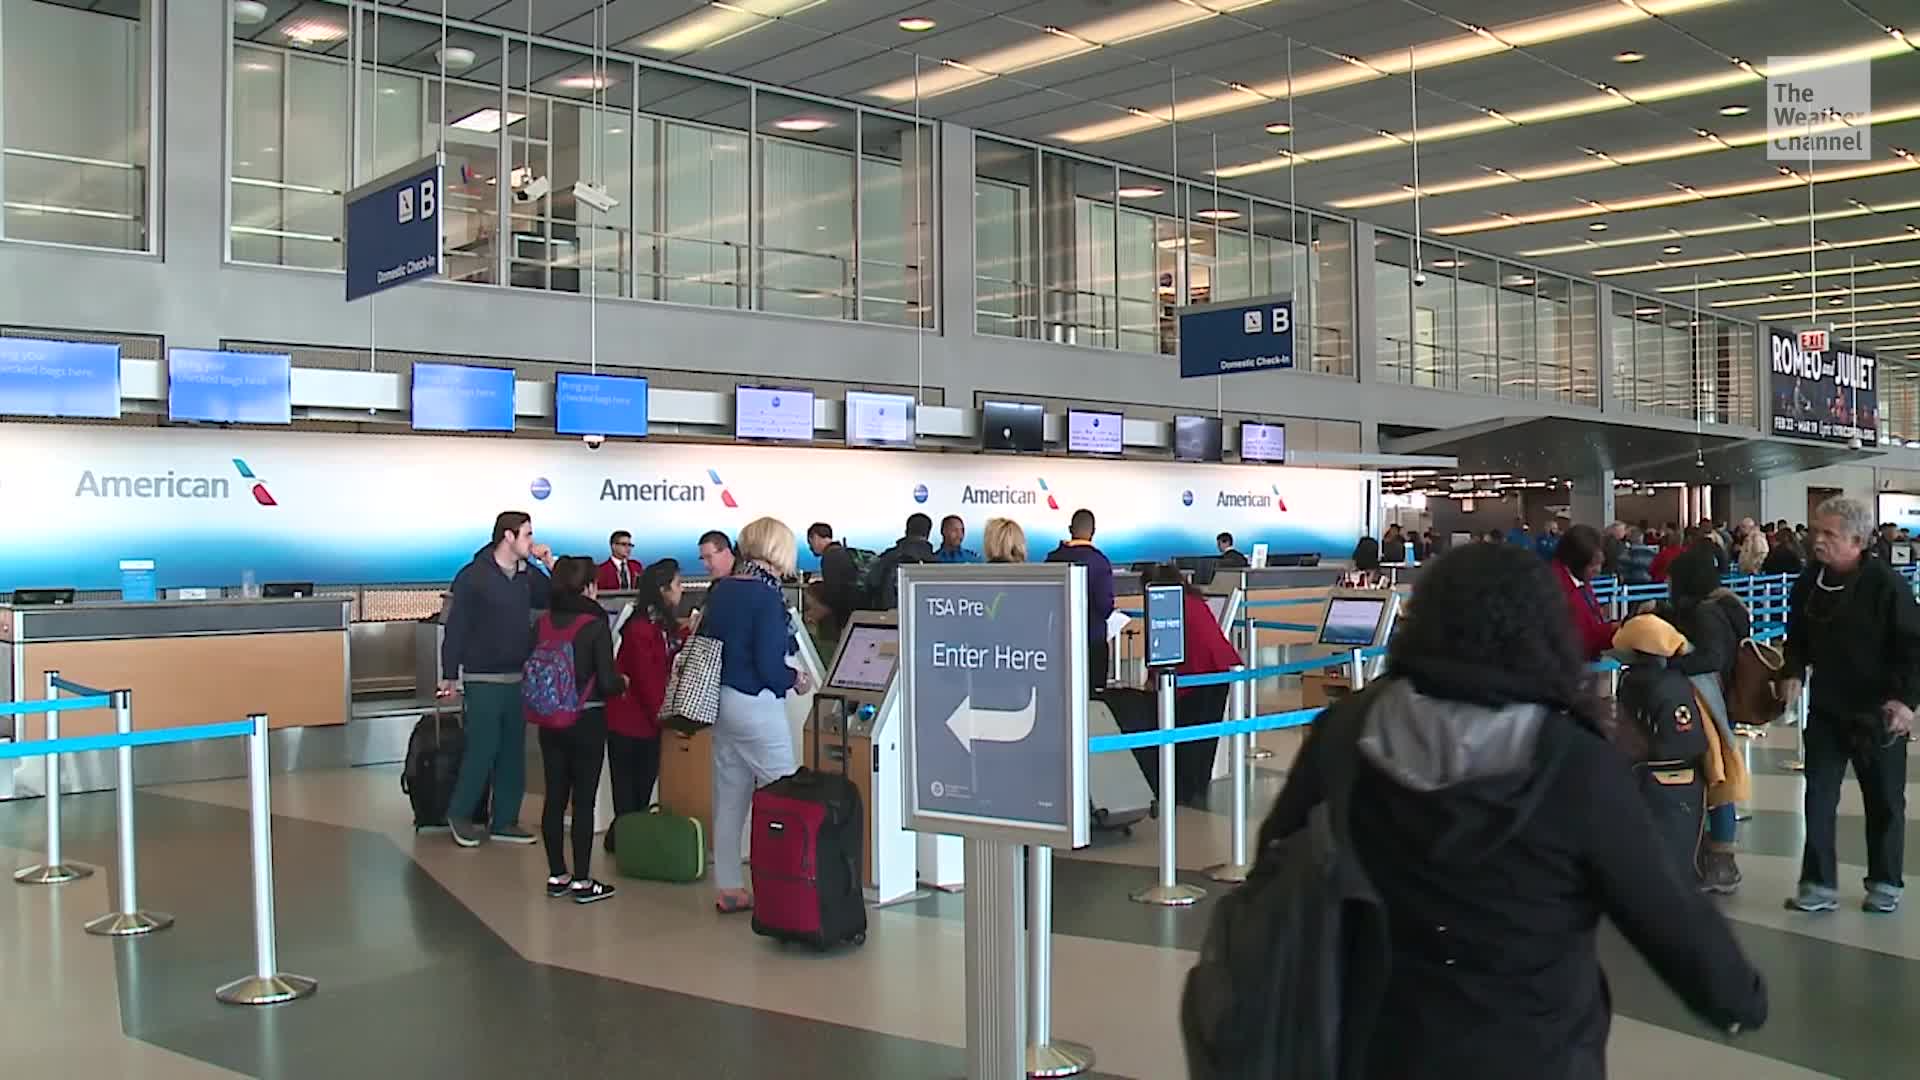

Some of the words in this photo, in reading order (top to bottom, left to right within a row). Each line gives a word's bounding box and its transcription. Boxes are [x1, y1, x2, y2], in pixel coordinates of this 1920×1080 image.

[421, 179, 436, 220] B
[377, 266, 406, 284] Domestic
[407, 255, 436, 274] Check-In
[1272, 307, 1290, 333] B
[1801, 333, 1825, 348] EXIT
[1220, 359, 1255, 370] Domestic
[1256, 354, 1290, 366] Check-In
[1772, 334, 1822, 381] ROMEO
[1835, 351, 1875, 390] JULIET
[75, 469, 230, 498] American
[600, 479, 705, 501] American
[961, 484, 1036, 504] American
[1216, 491, 1271, 507] American
[926, 597, 955, 616] TSA
[958, 599, 984, 617] Pre
[932, 642, 988, 668] Enter
[994, 645, 1048, 670] Here
